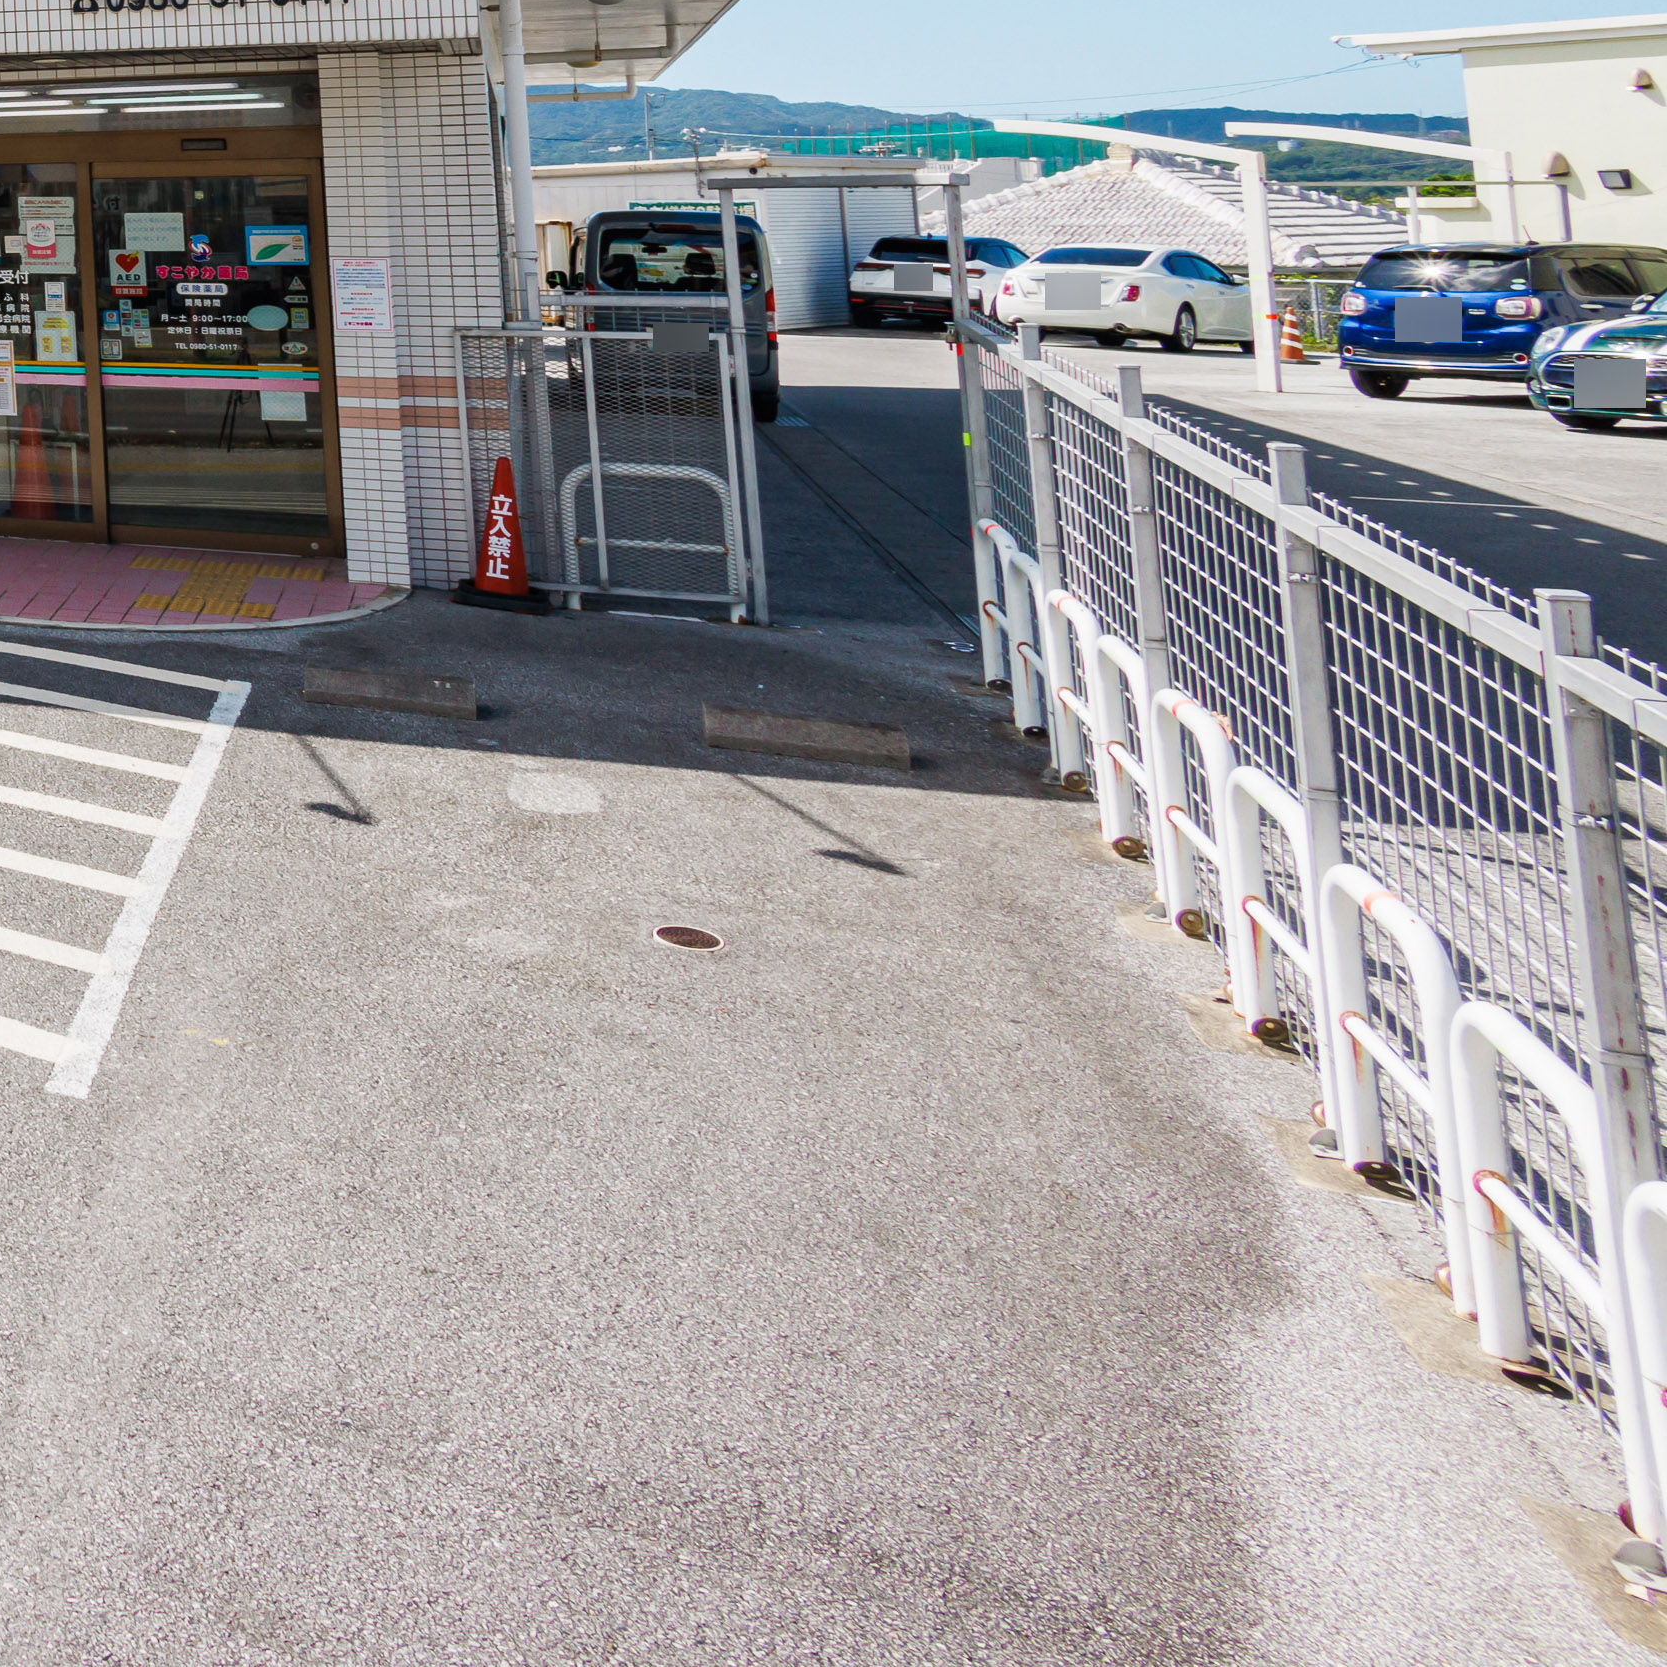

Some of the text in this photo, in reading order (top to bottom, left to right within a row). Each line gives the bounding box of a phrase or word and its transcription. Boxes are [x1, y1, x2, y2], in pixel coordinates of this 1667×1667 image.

[156, 265, 249, 280] すこやか薬局
[180, 284, 225, 293] 保険薬局
[486, 494, 513, 580] 立入禁止
